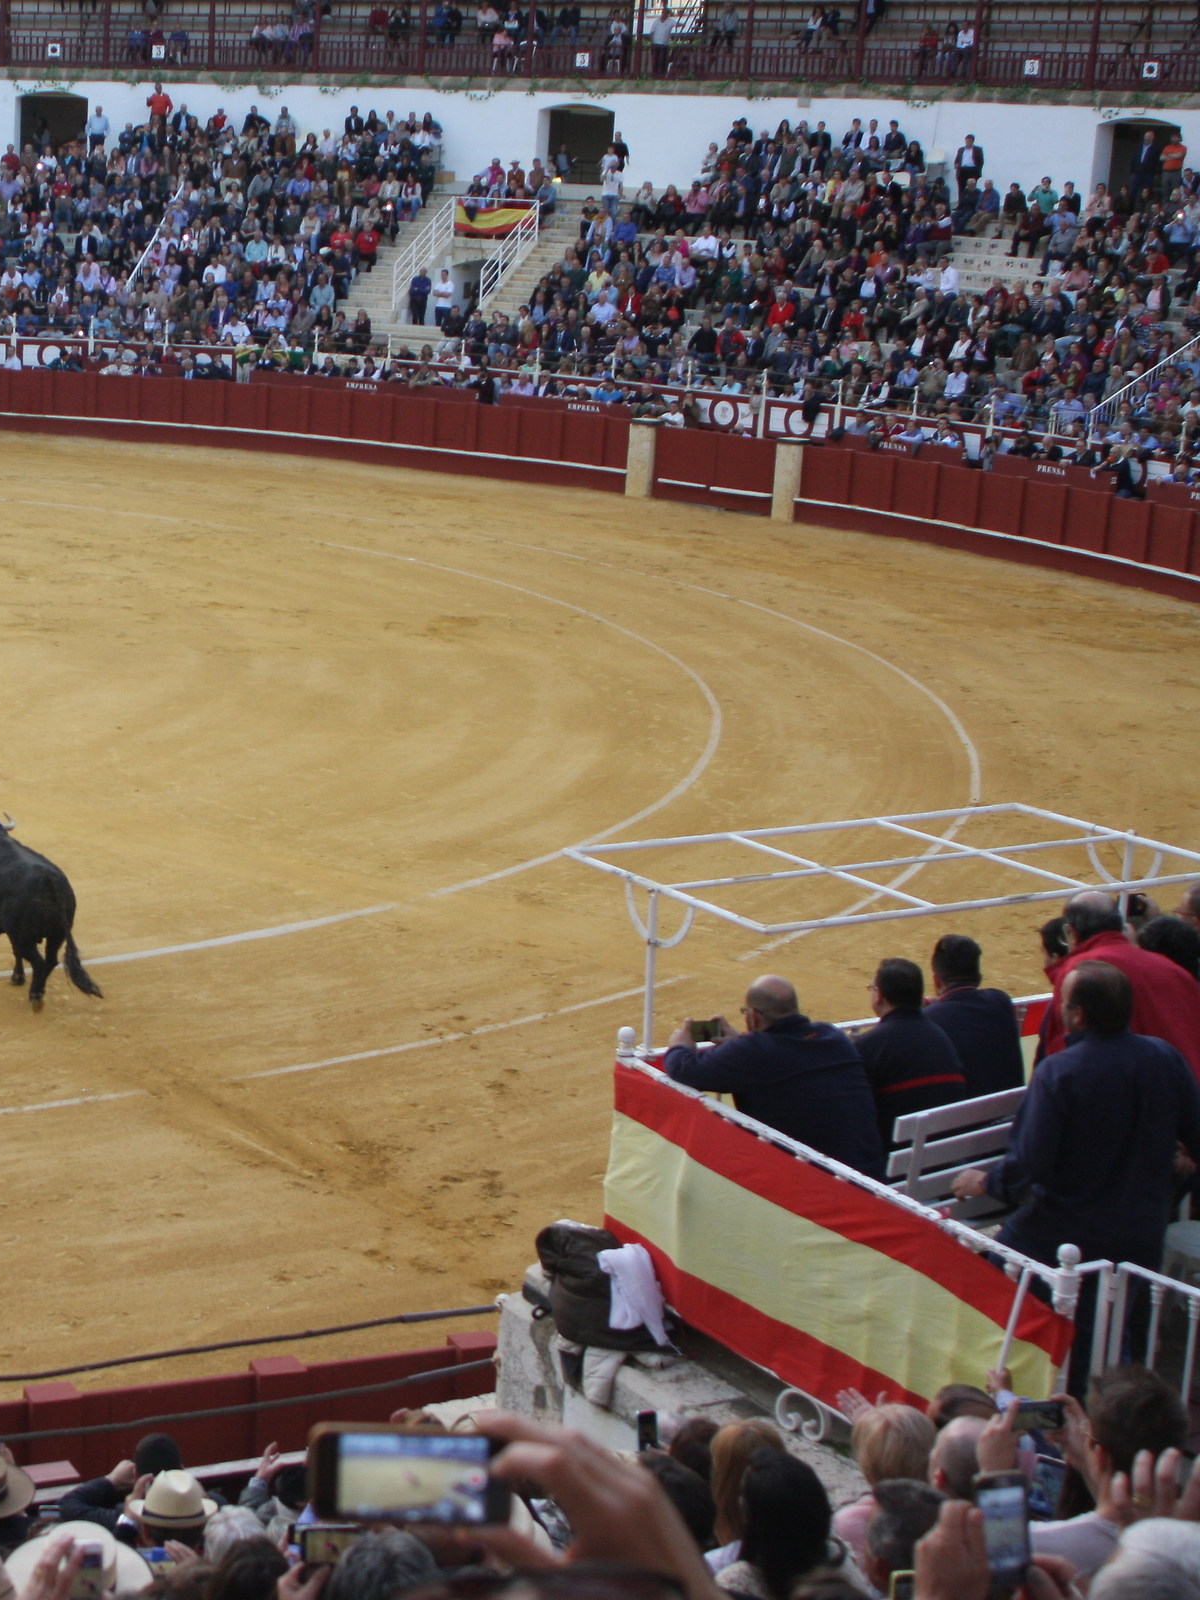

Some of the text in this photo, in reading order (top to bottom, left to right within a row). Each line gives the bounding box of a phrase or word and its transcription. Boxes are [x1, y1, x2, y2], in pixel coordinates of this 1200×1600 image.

[345, 381, 378, 391] EMPRESA
[567, 403, 600, 413] EMPRESA
[879, 442, 907, 452] PRENSA
[1037, 464, 1066, 476] PRENSA
